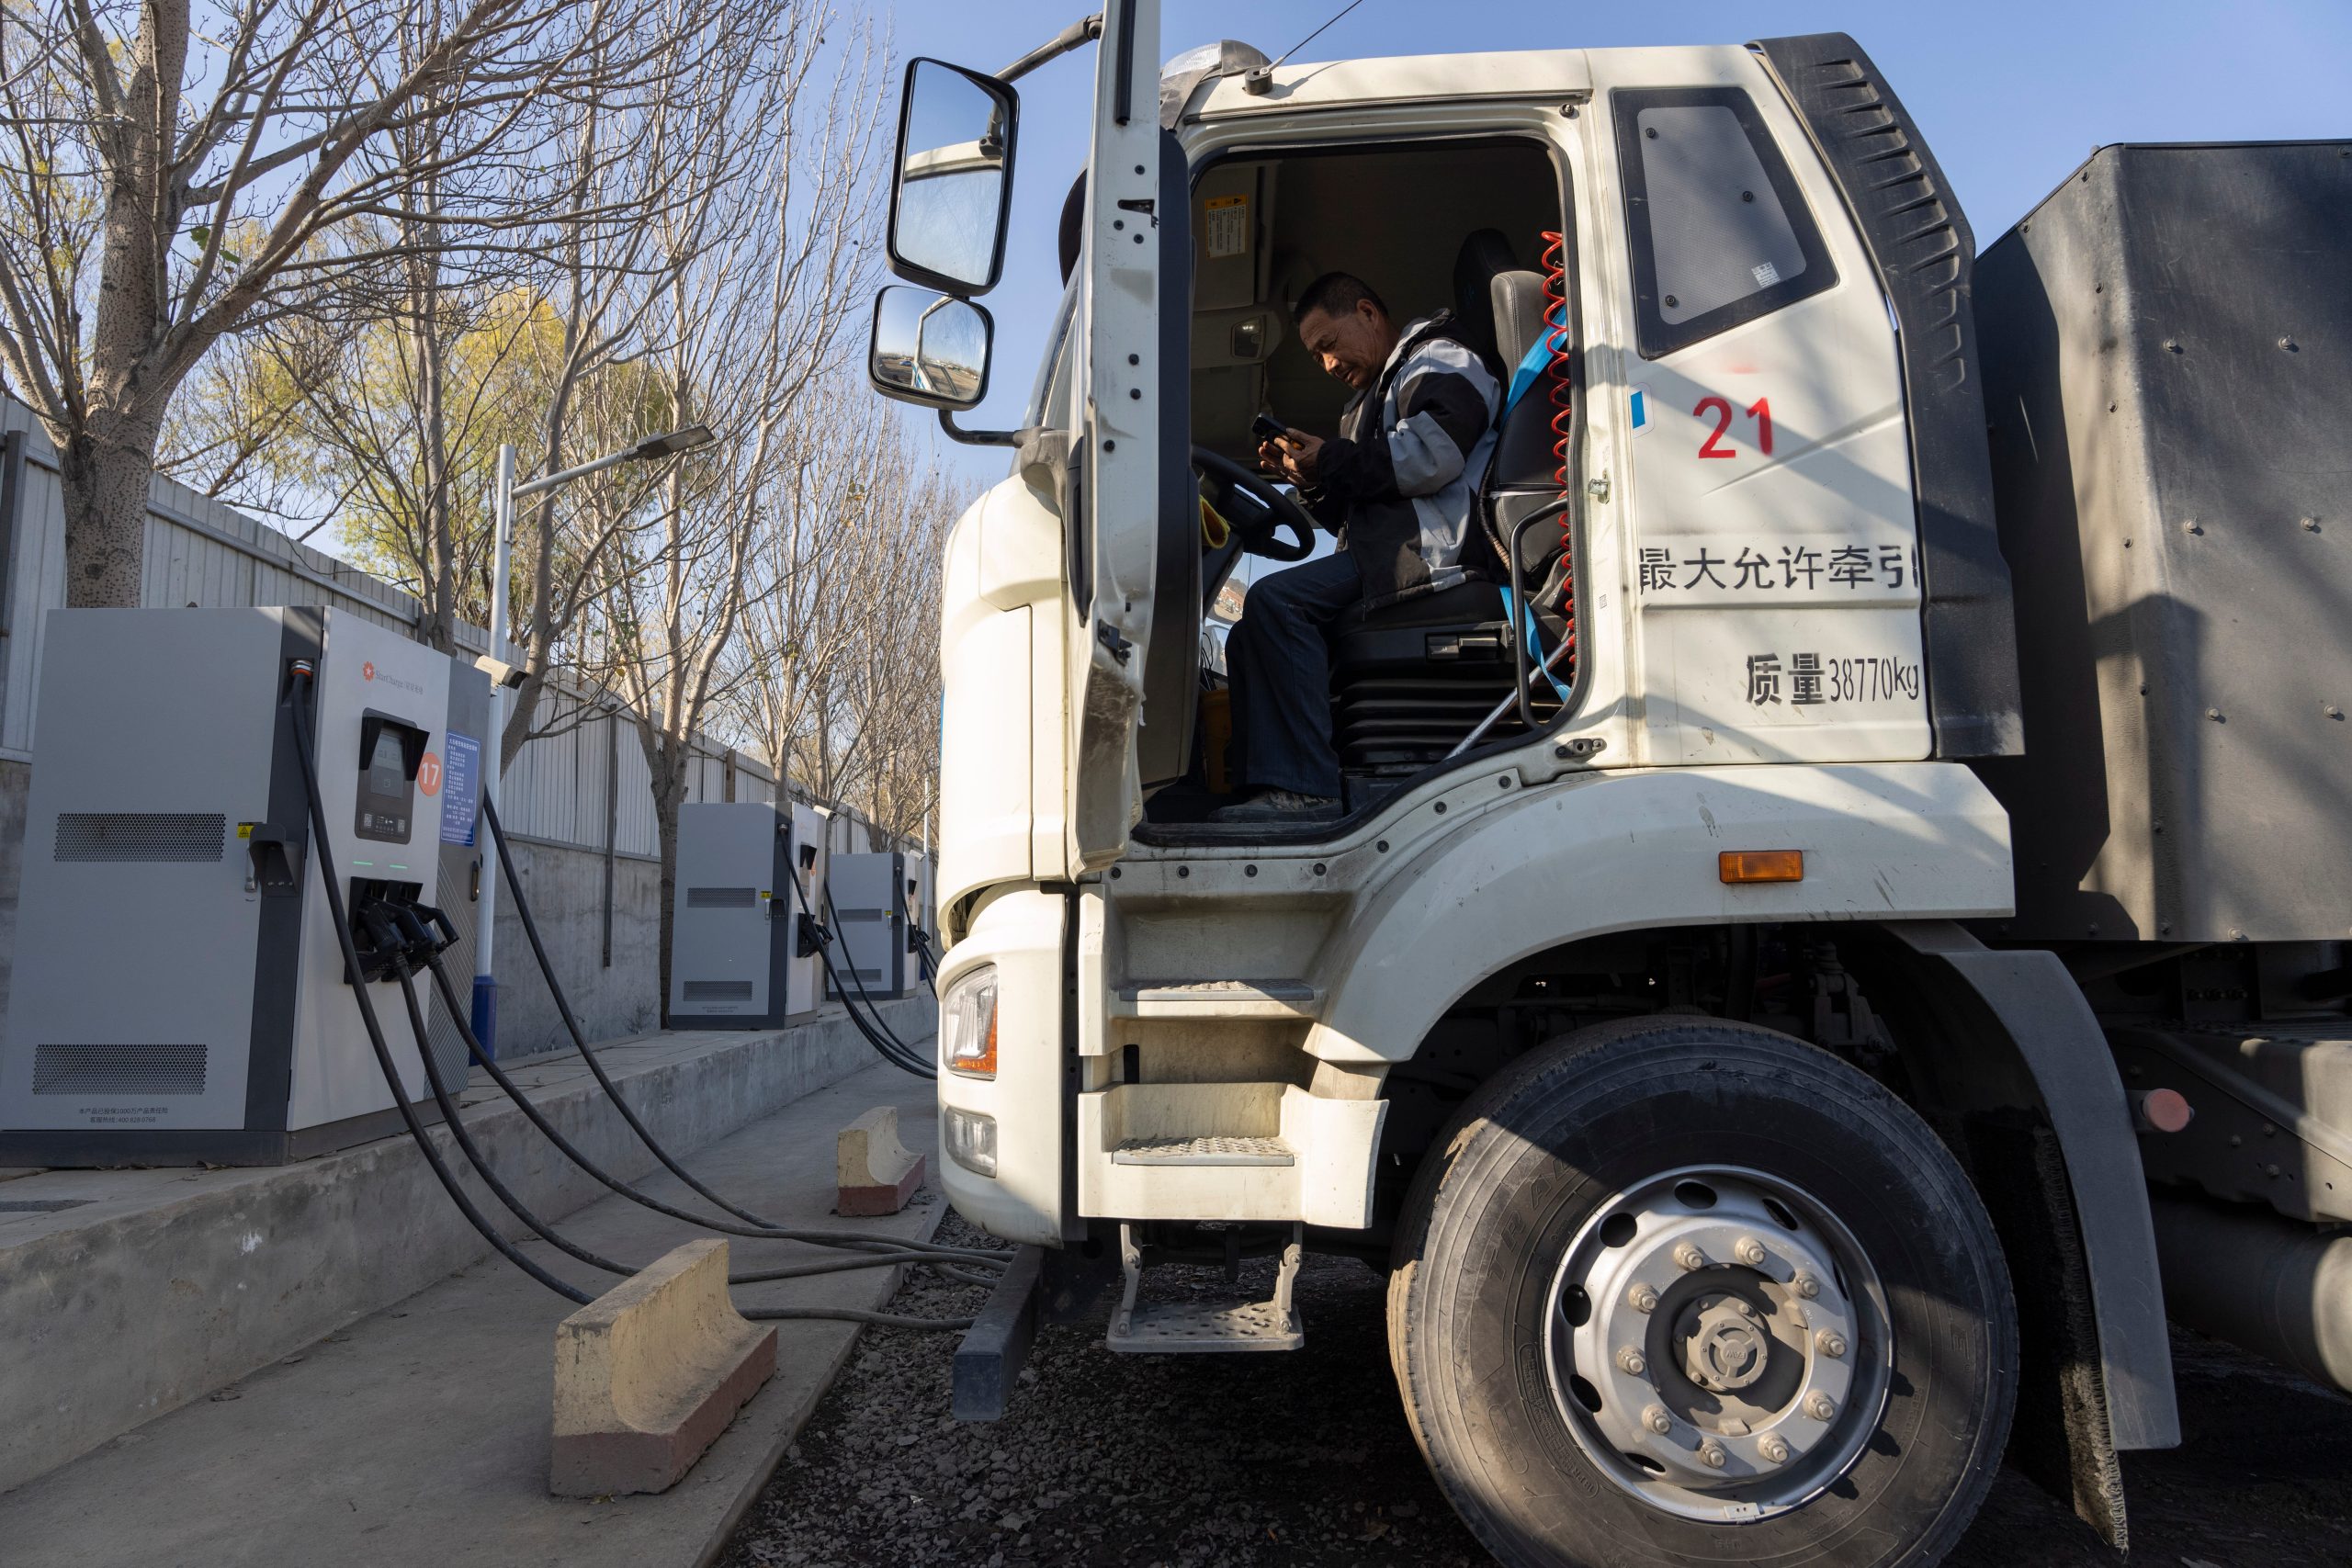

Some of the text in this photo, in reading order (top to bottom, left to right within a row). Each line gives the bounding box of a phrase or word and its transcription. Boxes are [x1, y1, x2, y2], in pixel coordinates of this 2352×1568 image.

[1693, 397, 1774, 458] 21
[1638, 544, 1918, 595] 最大允许牵引
[422, 763, 439, 786] 17
[1724, 1349, 1747, 1359] FAW
